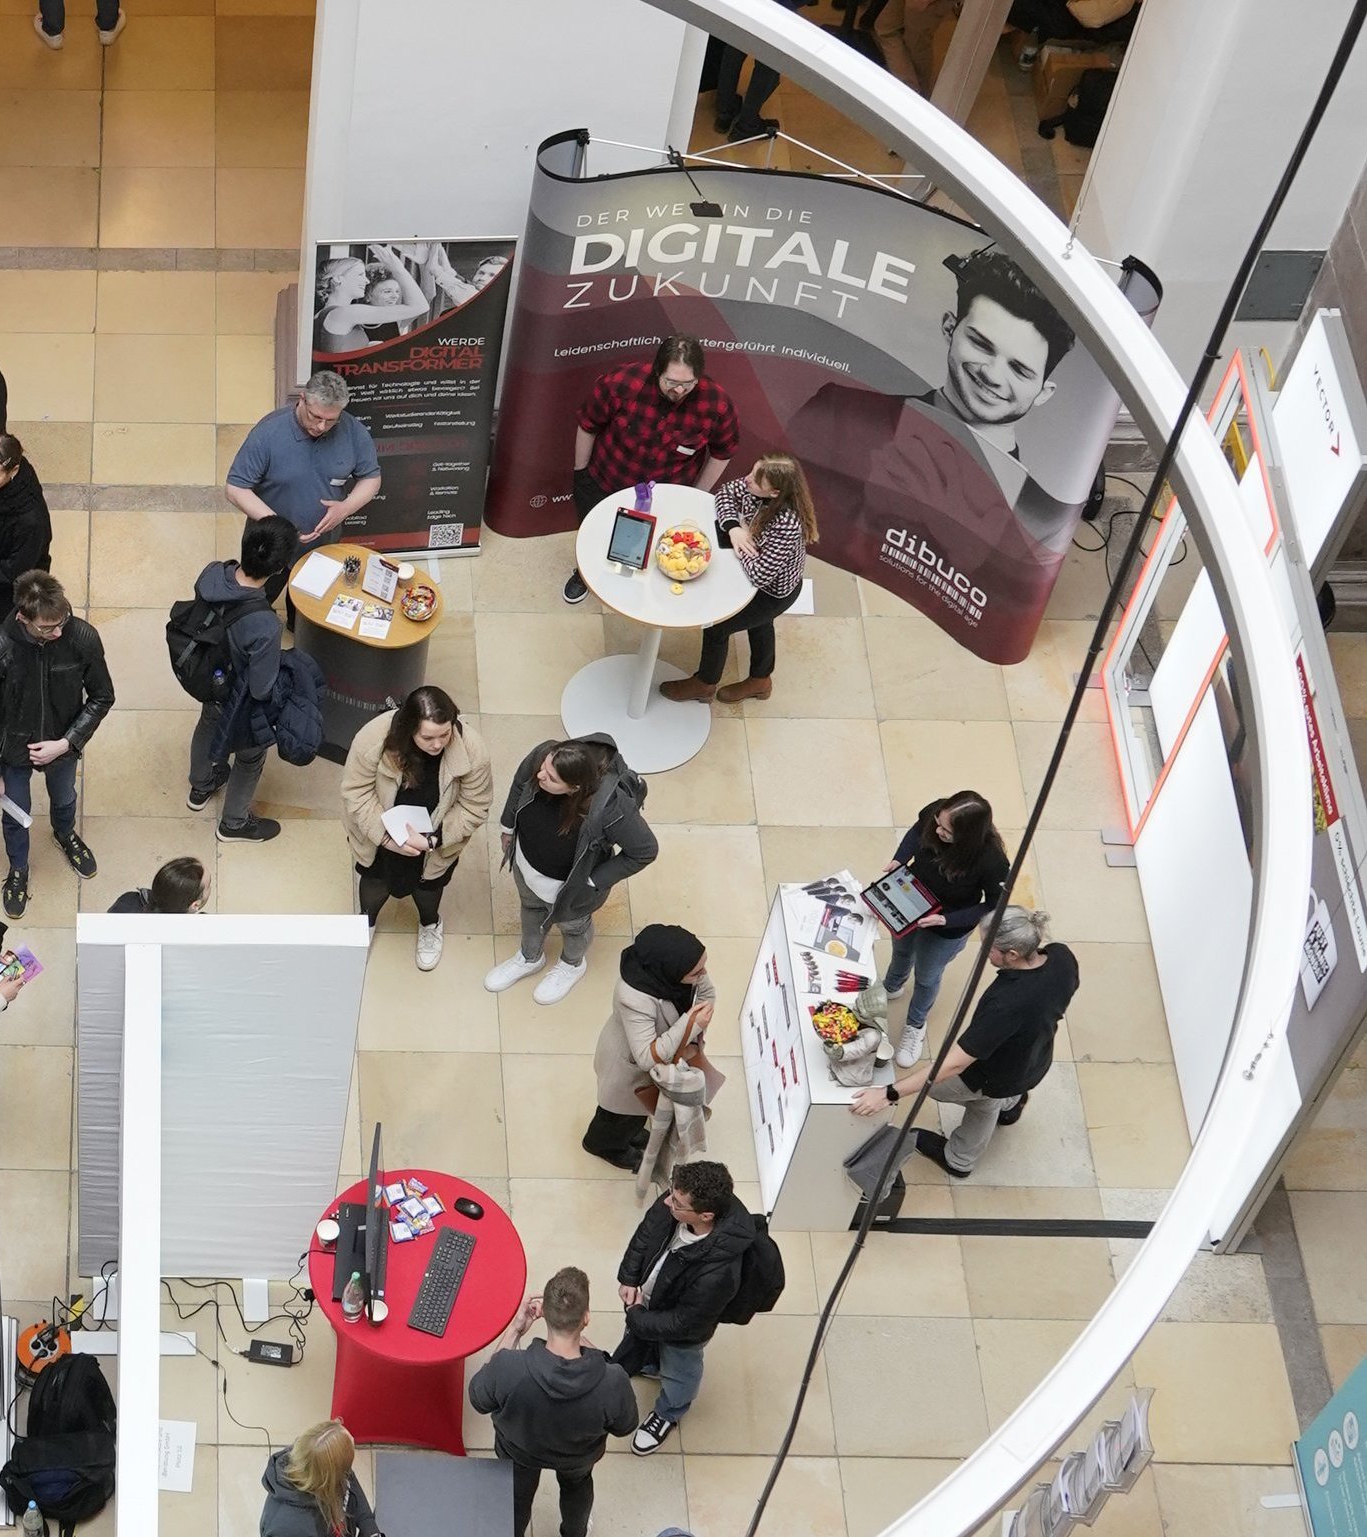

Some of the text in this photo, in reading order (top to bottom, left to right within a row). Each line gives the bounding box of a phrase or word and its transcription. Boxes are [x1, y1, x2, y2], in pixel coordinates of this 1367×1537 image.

[577, 209, 629, 228] DER
[646, 203, 690, 218] WE
[766, 207, 813, 224] DIE
[569, 222, 916, 303] DIGITALE
[563, 272, 859, 318] ZUKUNFT
[410, 346, 485, 359] DIGITAL
[438, 337, 485, 346] WERDE
[781, 345, 851, 374] Individuell.
[334, 358, 483, 377] TRANSFORMER
[1314, 363, 1334, 434] VECTOR
[885, 528, 987, 607] dibuco
[879, 555, 979, 629] solutions for the digital age
